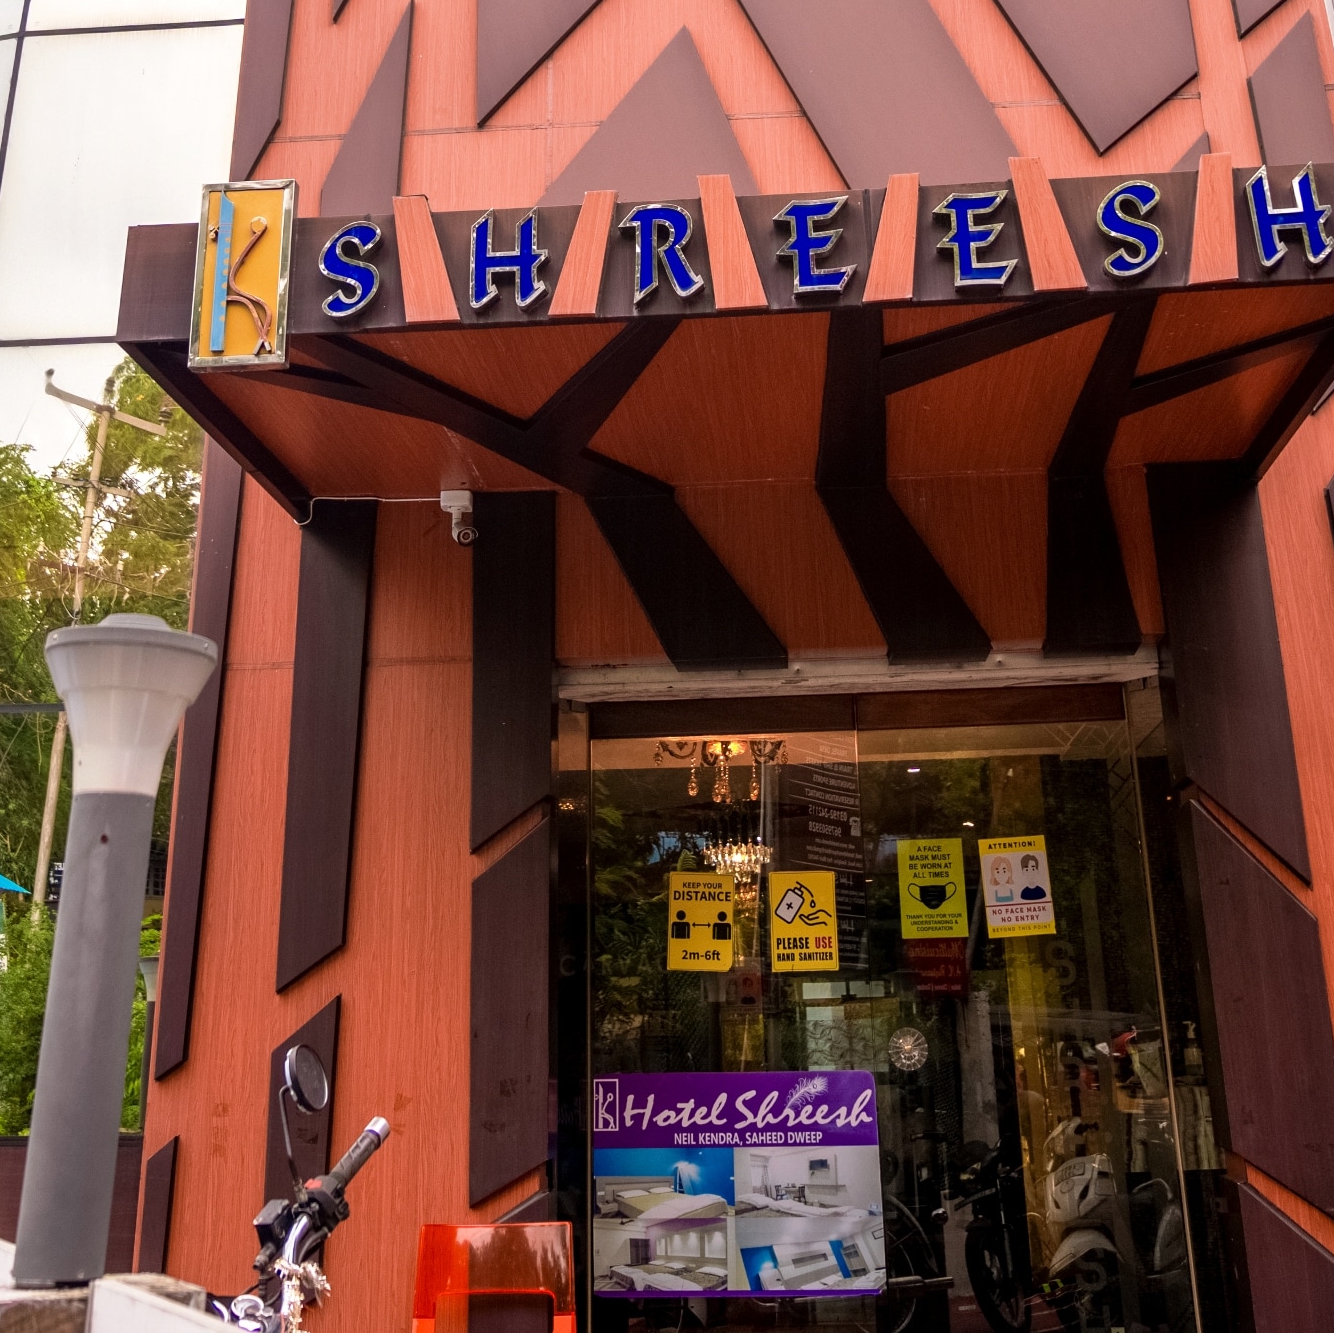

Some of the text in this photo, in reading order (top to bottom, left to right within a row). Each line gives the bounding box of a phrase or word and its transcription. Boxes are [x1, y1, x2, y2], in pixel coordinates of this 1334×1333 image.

[988, 840, 1035, 849] ATTENTION!
[673, 890, 731, 902] DISTANCE
[1015, 914, 1040, 922] ENTRY
[776, 937, 810, 949] PLEASE
[814, 936, 833, 949] USE
[682, 950, 720, 960] 2m-6ft
[777, 952, 833, 962] HAND SANITIZER
[624, 1093, 728, 1130] Hotel
[734, 1089, 873, 1130] Shreesh
[674, 1131, 823, 1146] NEIL KENDRA, SAHEED DWEEP
